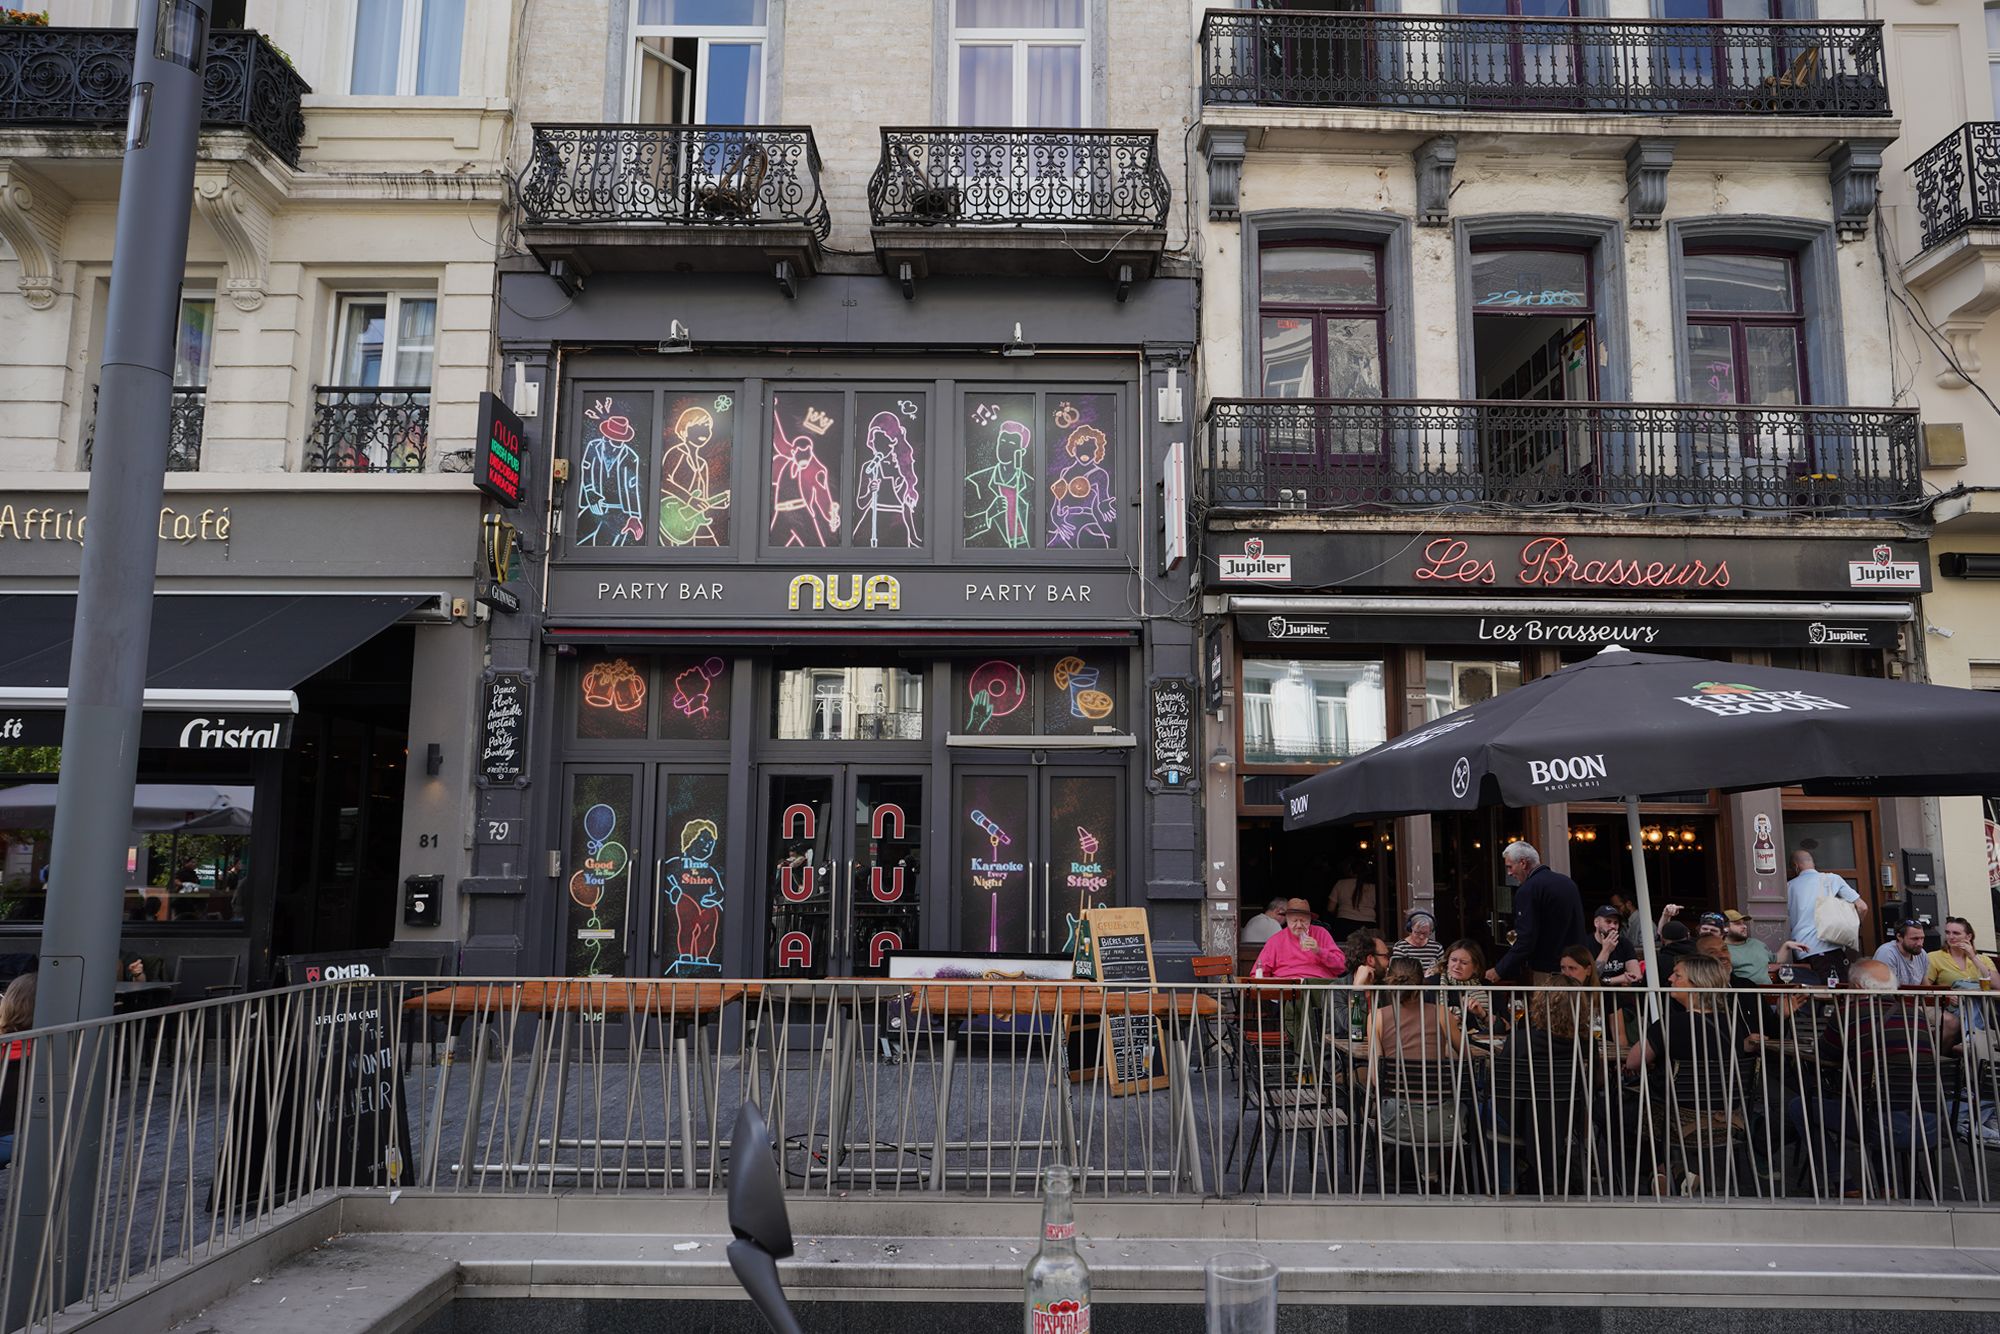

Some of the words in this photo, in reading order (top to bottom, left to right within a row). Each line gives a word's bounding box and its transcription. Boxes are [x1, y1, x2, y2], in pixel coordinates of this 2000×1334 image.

[494, 420, 519, 454] NUA
[491, 438, 507, 463] IRISH
[507, 451, 520, 472] PUB
[489, 452, 519, 486] DISCOBAR
[489, 467, 518, 500] KARAOKE
[158, 507, 230, 540] Café
[1225, 559, 1286, 576] Jupiler
[1414, 537, 1497, 584] Les
[1517, 536, 1732, 588] Brasseurs
[1856, 566, 1915, 582] Jupiler
[491, 584, 517, 609] GUINNESS
[598, 583, 668, 600] PARTY
[679, 583, 723, 600] BAR
[788, 574, 901, 610] NUA
[965, 584, 1037, 601] PARTY
[1047, 585, 1091, 601] BAR
[1478, 618, 1522, 641] Les
[1525, 620, 1659, 643] Brasseurs
[493, 684, 517, 694] Dance
[1155, 691, 1186, 703] Karaoke
[1673, 690, 1825, 707] KRIEK
[488, 704, 522, 720] Available
[816, 701, 887, 714] ARTOIS
[1695, 698, 1851, 717] BOON
[1155, 717, 1188, 731] Birthday
[179, 718, 280, 748] Cristal
[489, 735, 519, 749] Party
[1155, 738, 1187, 749] Cocktail
[484, 747, 519, 761] Booking
[1527, 754, 1608, 785] BOON
[1290, 794, 1309, 816] BOON
[488, 821, 509, 840] 79
[419, 834, 438, 849] 81
[585, 859, 614, 869] Good
[681, 857, 710, 869] Time
[971, 858, 1023, 871] Karaoke
[1071, 862, 1102, 873] Rock
[584, 873, 605, 885] You
[682, 873, 714, 885] Shine
[973, 875, 1004, 889] Night
[987, 871, 1008, 879] Every
[1067, 875, 1108, 892] Stage
